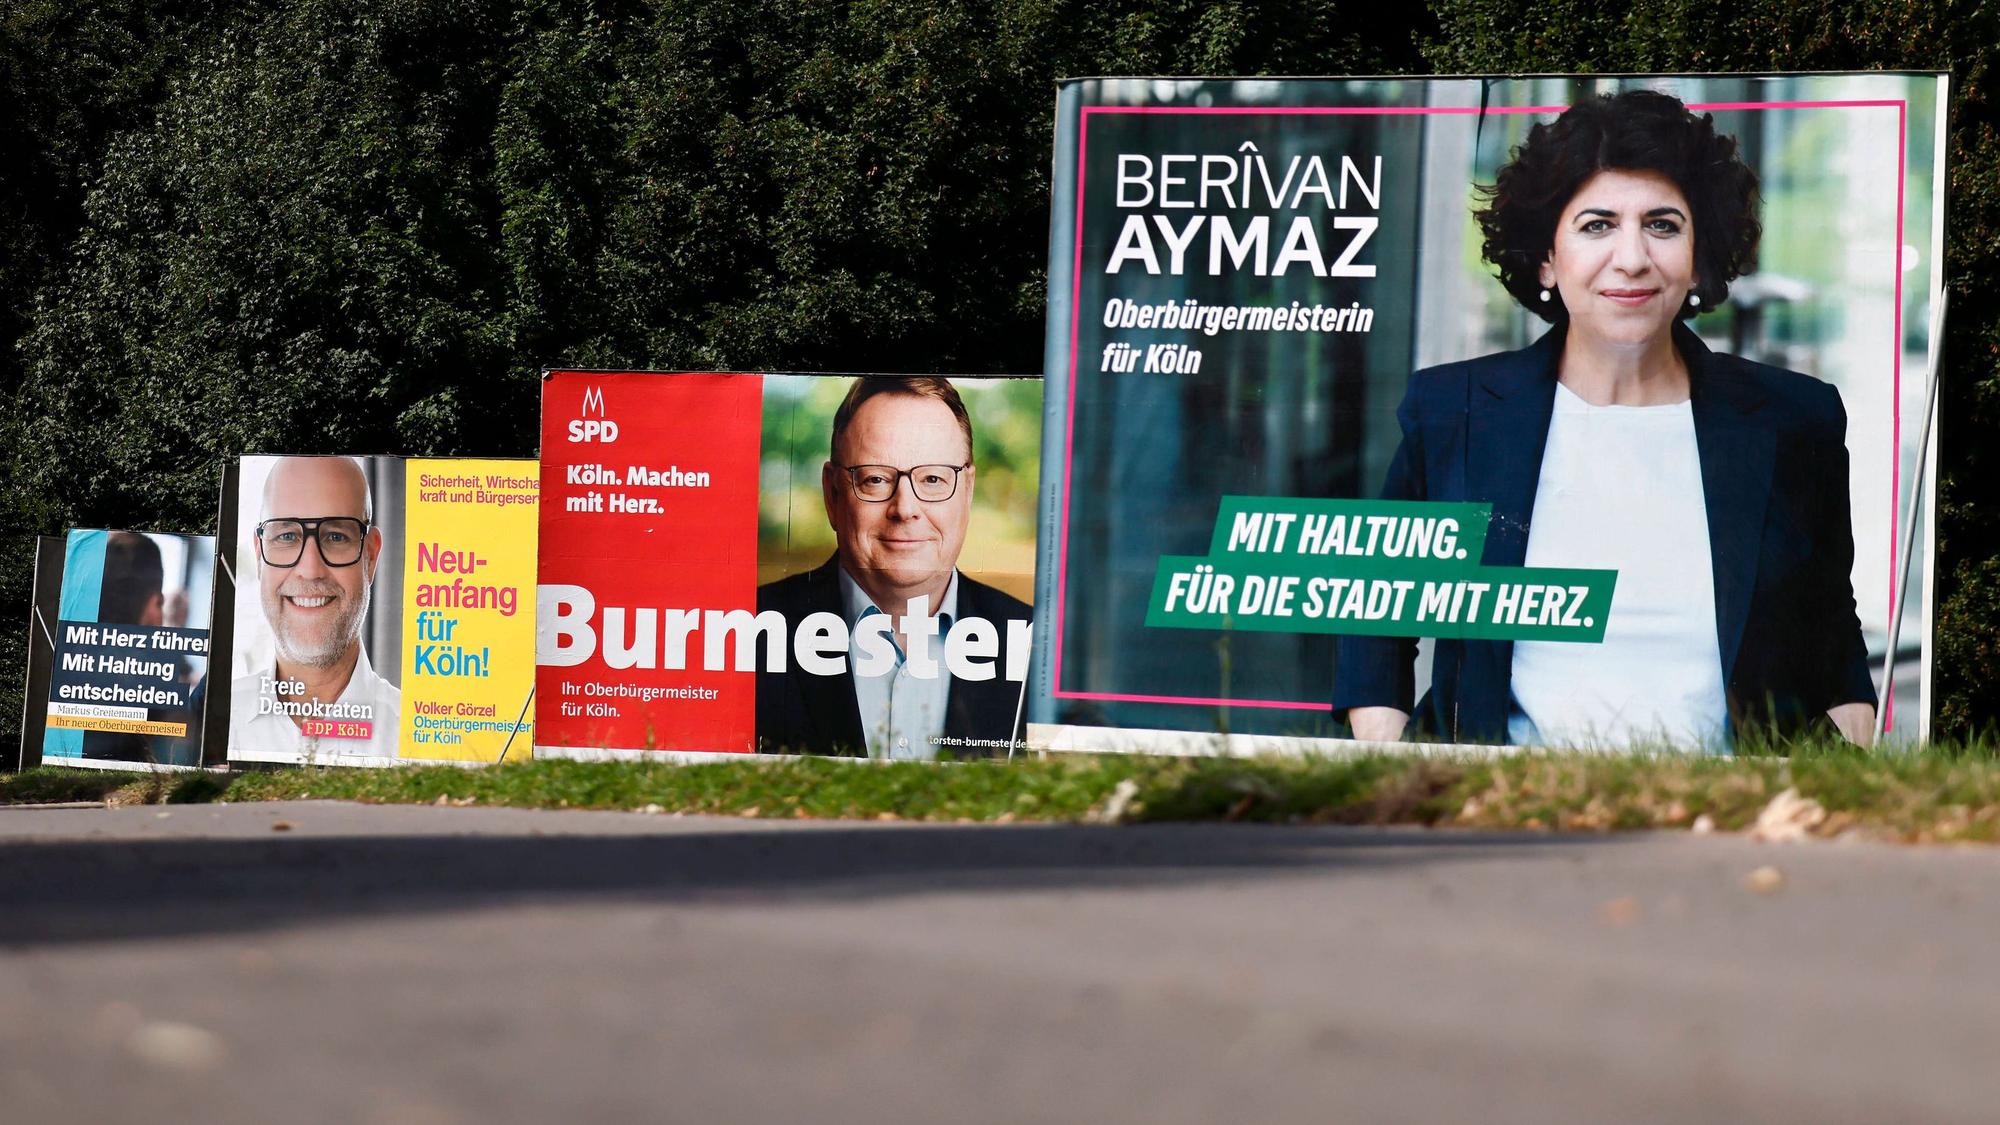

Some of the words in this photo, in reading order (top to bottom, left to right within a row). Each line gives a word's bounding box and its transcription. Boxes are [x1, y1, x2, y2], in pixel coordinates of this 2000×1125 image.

[1116, 141, 1382, 209] BERÎVAN
[1105, 214, 1379, 277] AYMAZ
[1103, 298, 1374, 336] Oberbürgermeisterin
[1100, 342, 1142, 373] für
[1144, 343, 1202, 374] Köln
[568, 420, 619, 443] SPD
[419, 474, 483, 490] Sicherheit,
[567, 464, 622, 485] Köln.
[626, 466, 710, 487] Machen
[419, 489, 448, 503] kraft
[450, 491, 473, 504] und
[566, 491, 603, 512] mit
[609, 493, 664, 514] Herz.
[1227, 511, 1297, 555] MIT
[1298, 513, 1468, 559] HALTUNG.
[417, 542, 487, 574] Neu-
[416, 578, 517, 617] anfang
[1164, 564, 1233, 615] FÜR
[1237, 574, 1299, 617] DIE
[1302, 576, 1414, 621] STADT
[1417, 581, 1490, 624] MIT
[1498, 584, 1595, 628] HERZ.
[66, 625, 98, 646] Mit
[102, 628, 147, 649] Herz
[416, 611, 458, 642] für
[536, 584, 1033, 682] Burmester
[62, 653, 95, 672] Mit
[98, 655, 175, 682] Haltung
[415, 645, 489, 677] Köln!
[59, 682, 184, 706] entscheiden.
[260, 676, 305, 695] Freie
[561, 682, 581, 695] Ihr
[584, 682, 719, 702] Oberbürgermeister
[57, 705, 91, 716] Markus
[259, 697, 373, 719] Demokraten
[414, 701, 453, 714] Volker
[456, 703, 496, 717] Görzel
[561, 702, 582, 716] für
[586, 703, 621, 718] Köln.
[55, 717, 70, 727] Ihr
[71, 719, 97, 729] neuer
[98, 720, 185, 735] Oberbürgermeister
[306, 722, 333, 735] FDP
[338, 724, 368, 737] Köln
[413, 730, 430, 743] für
[434, 731, 461, 744] Köln
